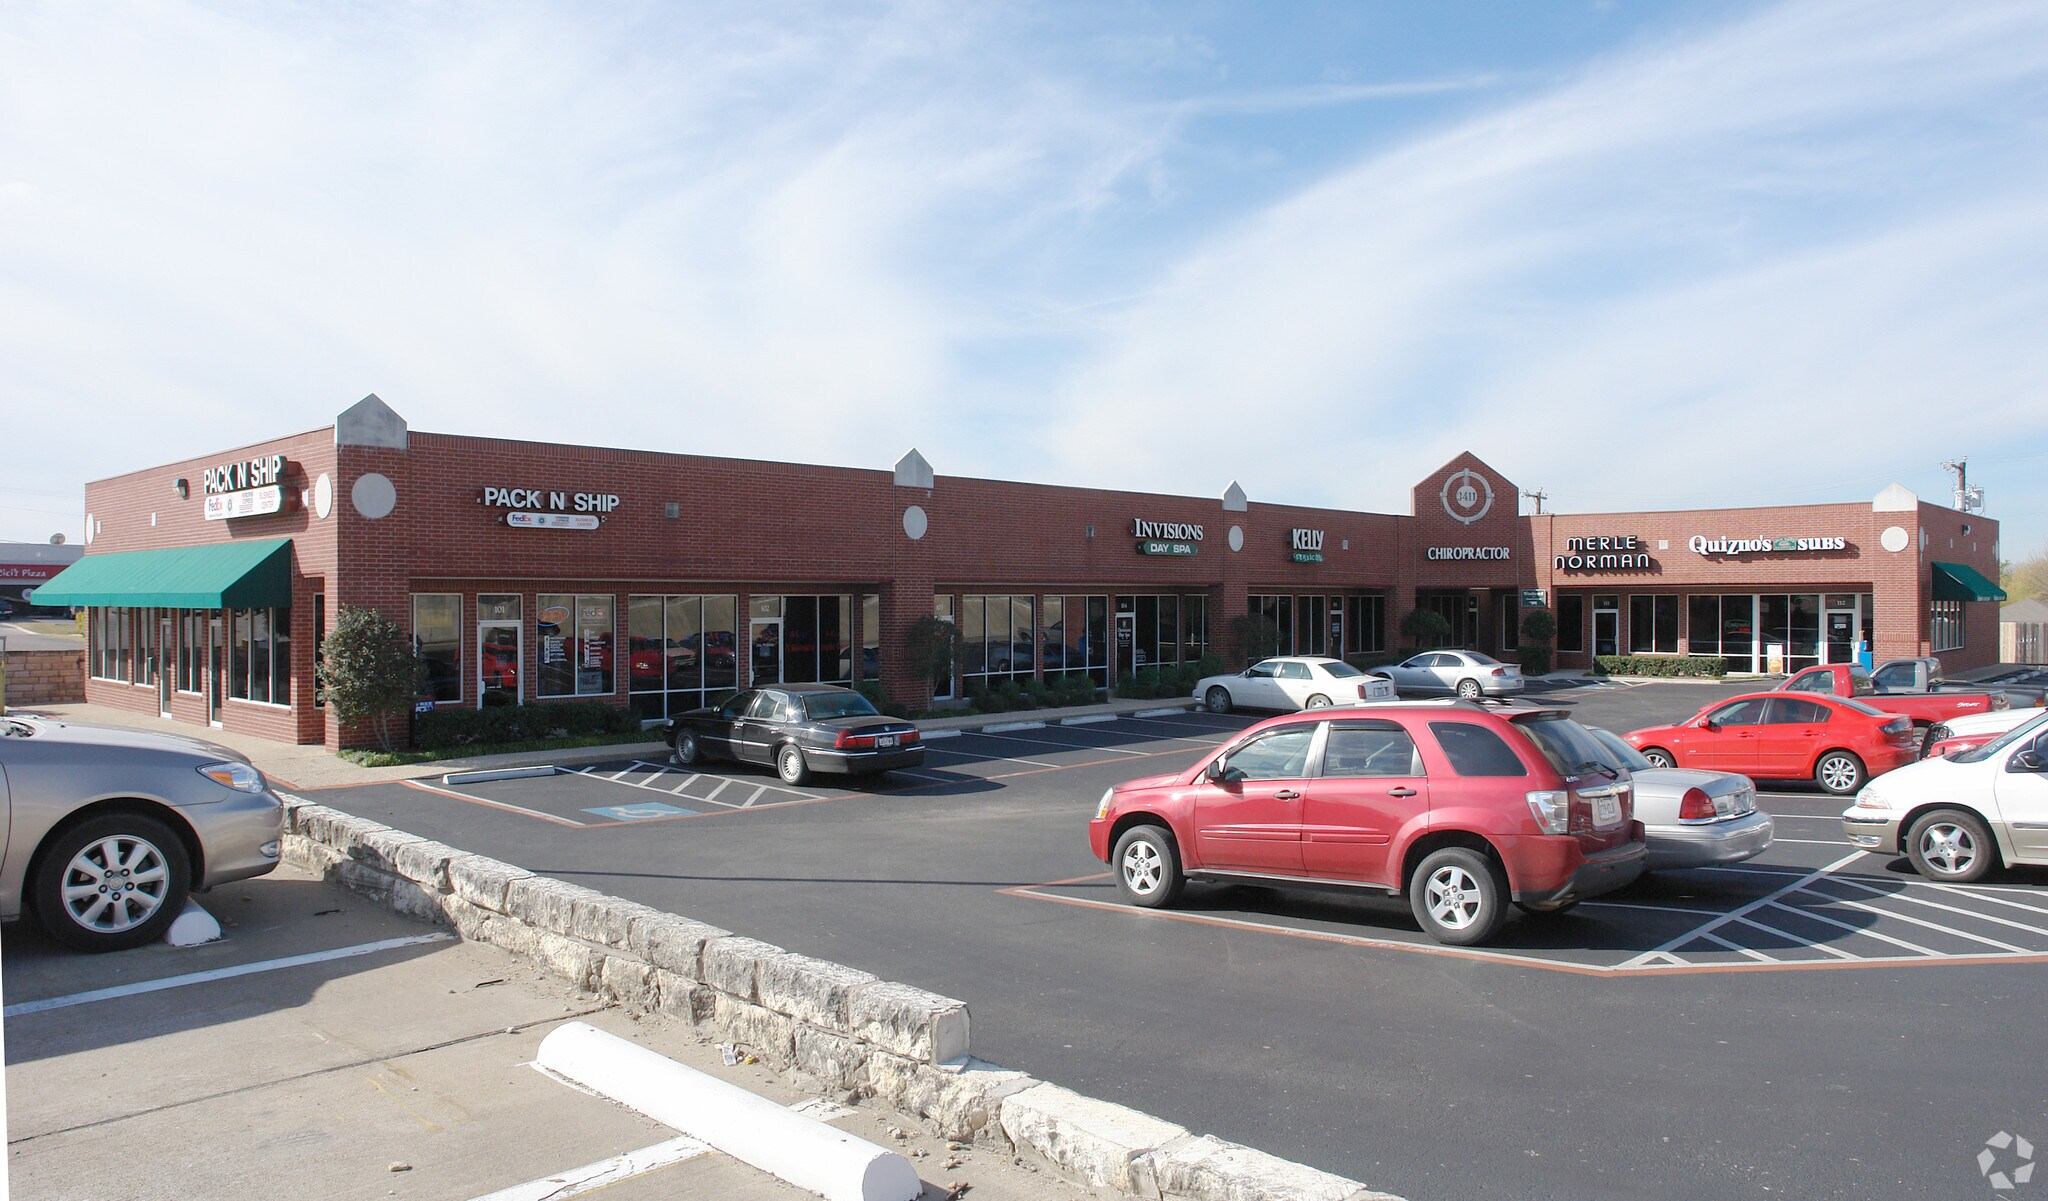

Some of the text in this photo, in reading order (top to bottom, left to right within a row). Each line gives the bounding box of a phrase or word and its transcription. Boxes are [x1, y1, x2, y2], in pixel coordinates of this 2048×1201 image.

[204, 454, 282, 494] PACK N SHIP
[484, 487, 620, 512] PACK N SHIP
[1457, 491, 1476, 502] 3411
[512, 514, 532, 522] FedEx
[1134, 518, 1204, 541] INVISIONS
[1292, 528, 1325, 550] KELLY
[1566, 536, 1636, 551] MERLE
[1688, 534, 1773, 555] Quizno's
[1797, 536, 1846, 551] SUBS
[1150, 543, 1191, 554] DAY SPA
[1427, 546, 1510, 560] CHIROPRACTOR
[1554, 554, 1649, 569] NORMAN
[494, 605, 505, 614] 101
